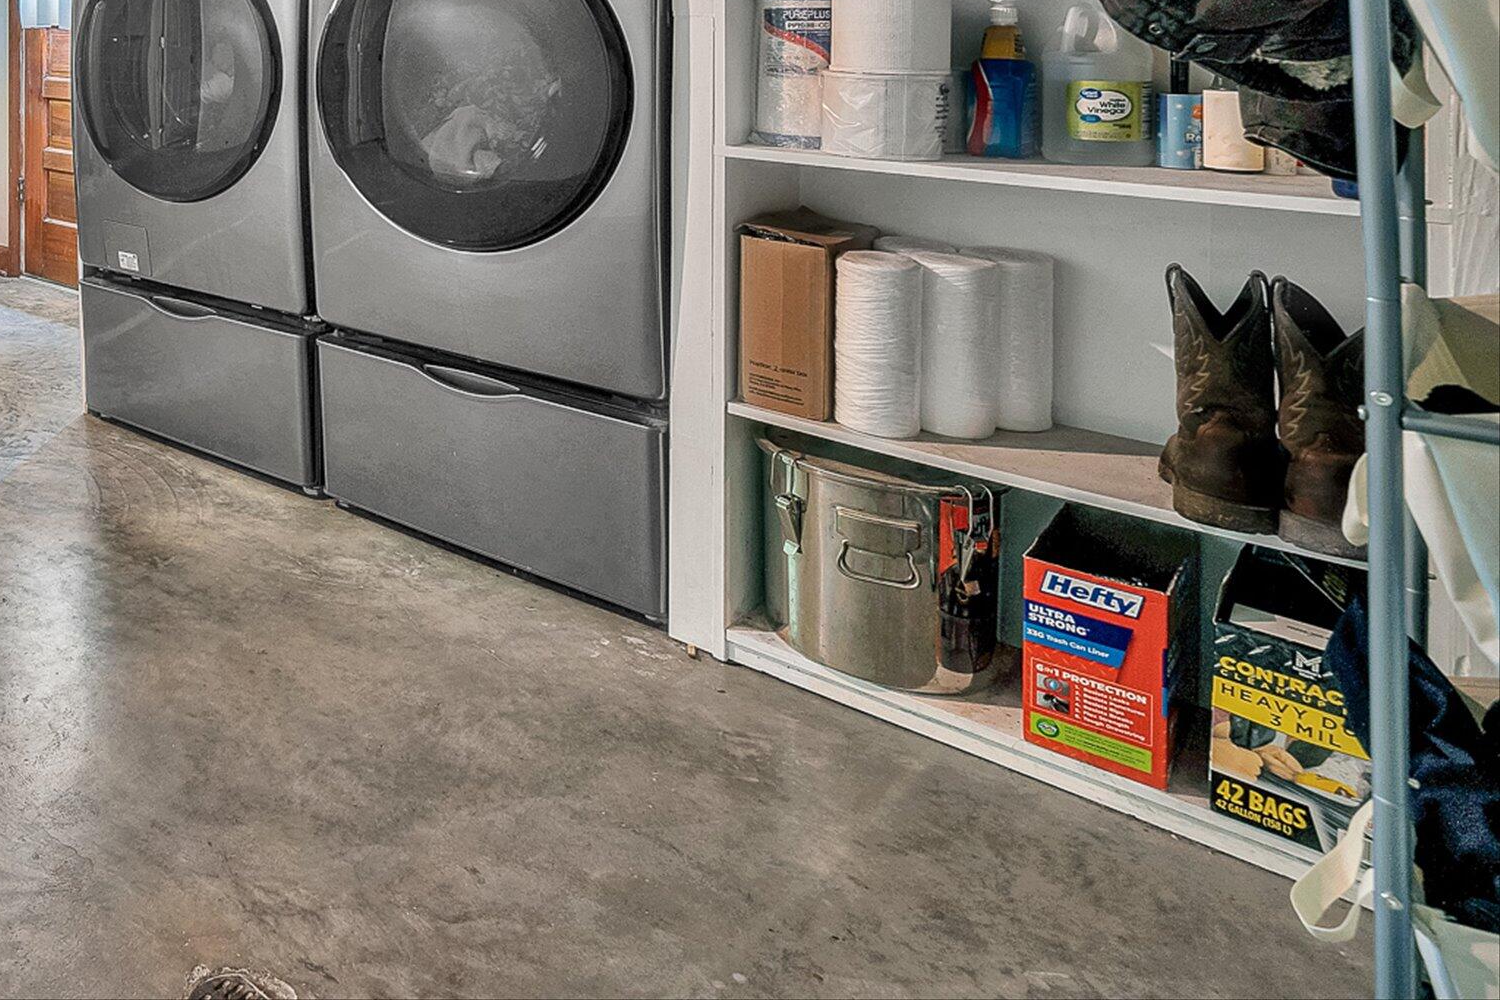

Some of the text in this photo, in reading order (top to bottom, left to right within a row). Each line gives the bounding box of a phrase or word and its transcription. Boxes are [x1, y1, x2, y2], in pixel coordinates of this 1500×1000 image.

[1087, 107, 1126, 115] Vinegar
[1047, 574, 1138, 615] Hefty
[1028, 603, 1076, 624] ULTRA
[1028, 612, 1088, 636] STRONG
[1046, 633, 1069, 646] Trash
[1069, 640, 1086, 652] Can
[1087, 645, 1110, 659] Liner
[1061, 670, 1148, 705] PROTECTION
[1219, 655, 1345, 707] CONTRAC
[1220, 682, 1308, 720] HEAVY
[1269, 713, 1342, 748] 3 MIL
[1216, 779, 1307, 830] 42 BAGS
[1227, 802, 1261, 824] GALLON
